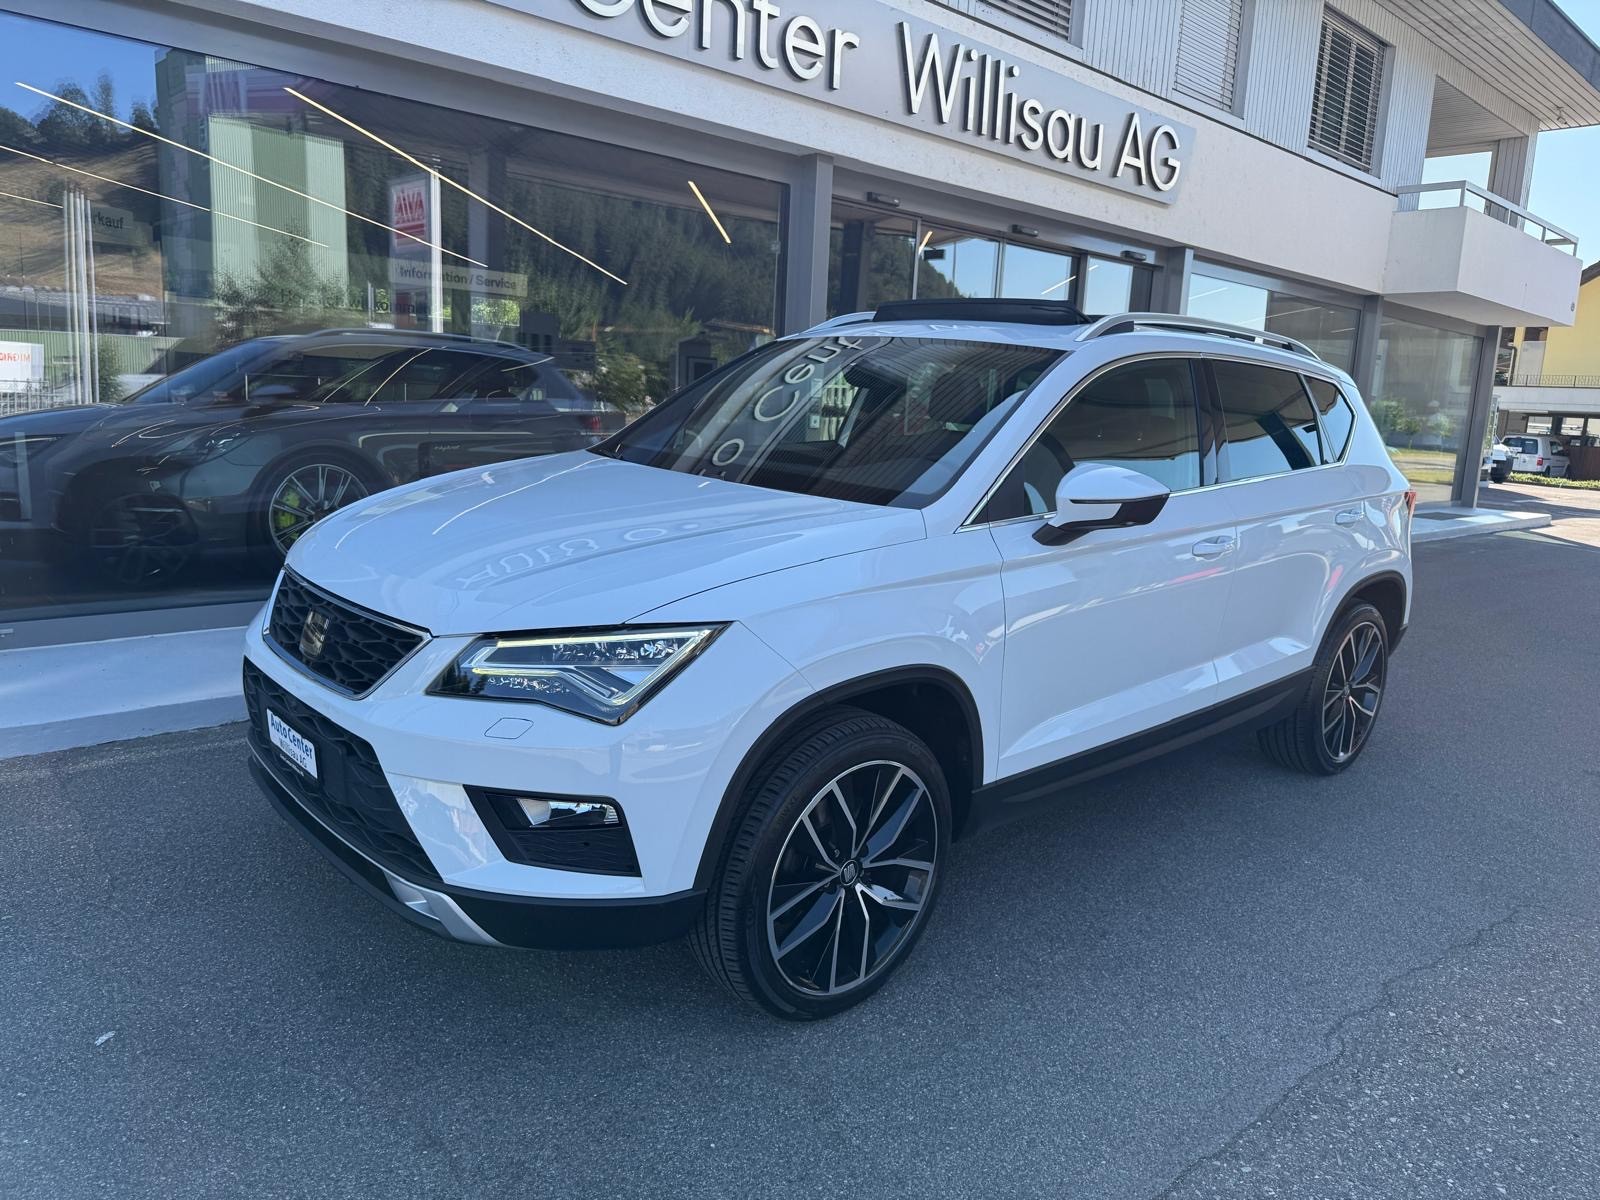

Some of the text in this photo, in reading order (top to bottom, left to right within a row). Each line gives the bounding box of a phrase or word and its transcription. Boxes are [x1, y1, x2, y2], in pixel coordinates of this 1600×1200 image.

[900, 21, 1104, 172] Willisau
[1116, 112, 1182, 192] AG
[475, 275, 516, 290] Service
